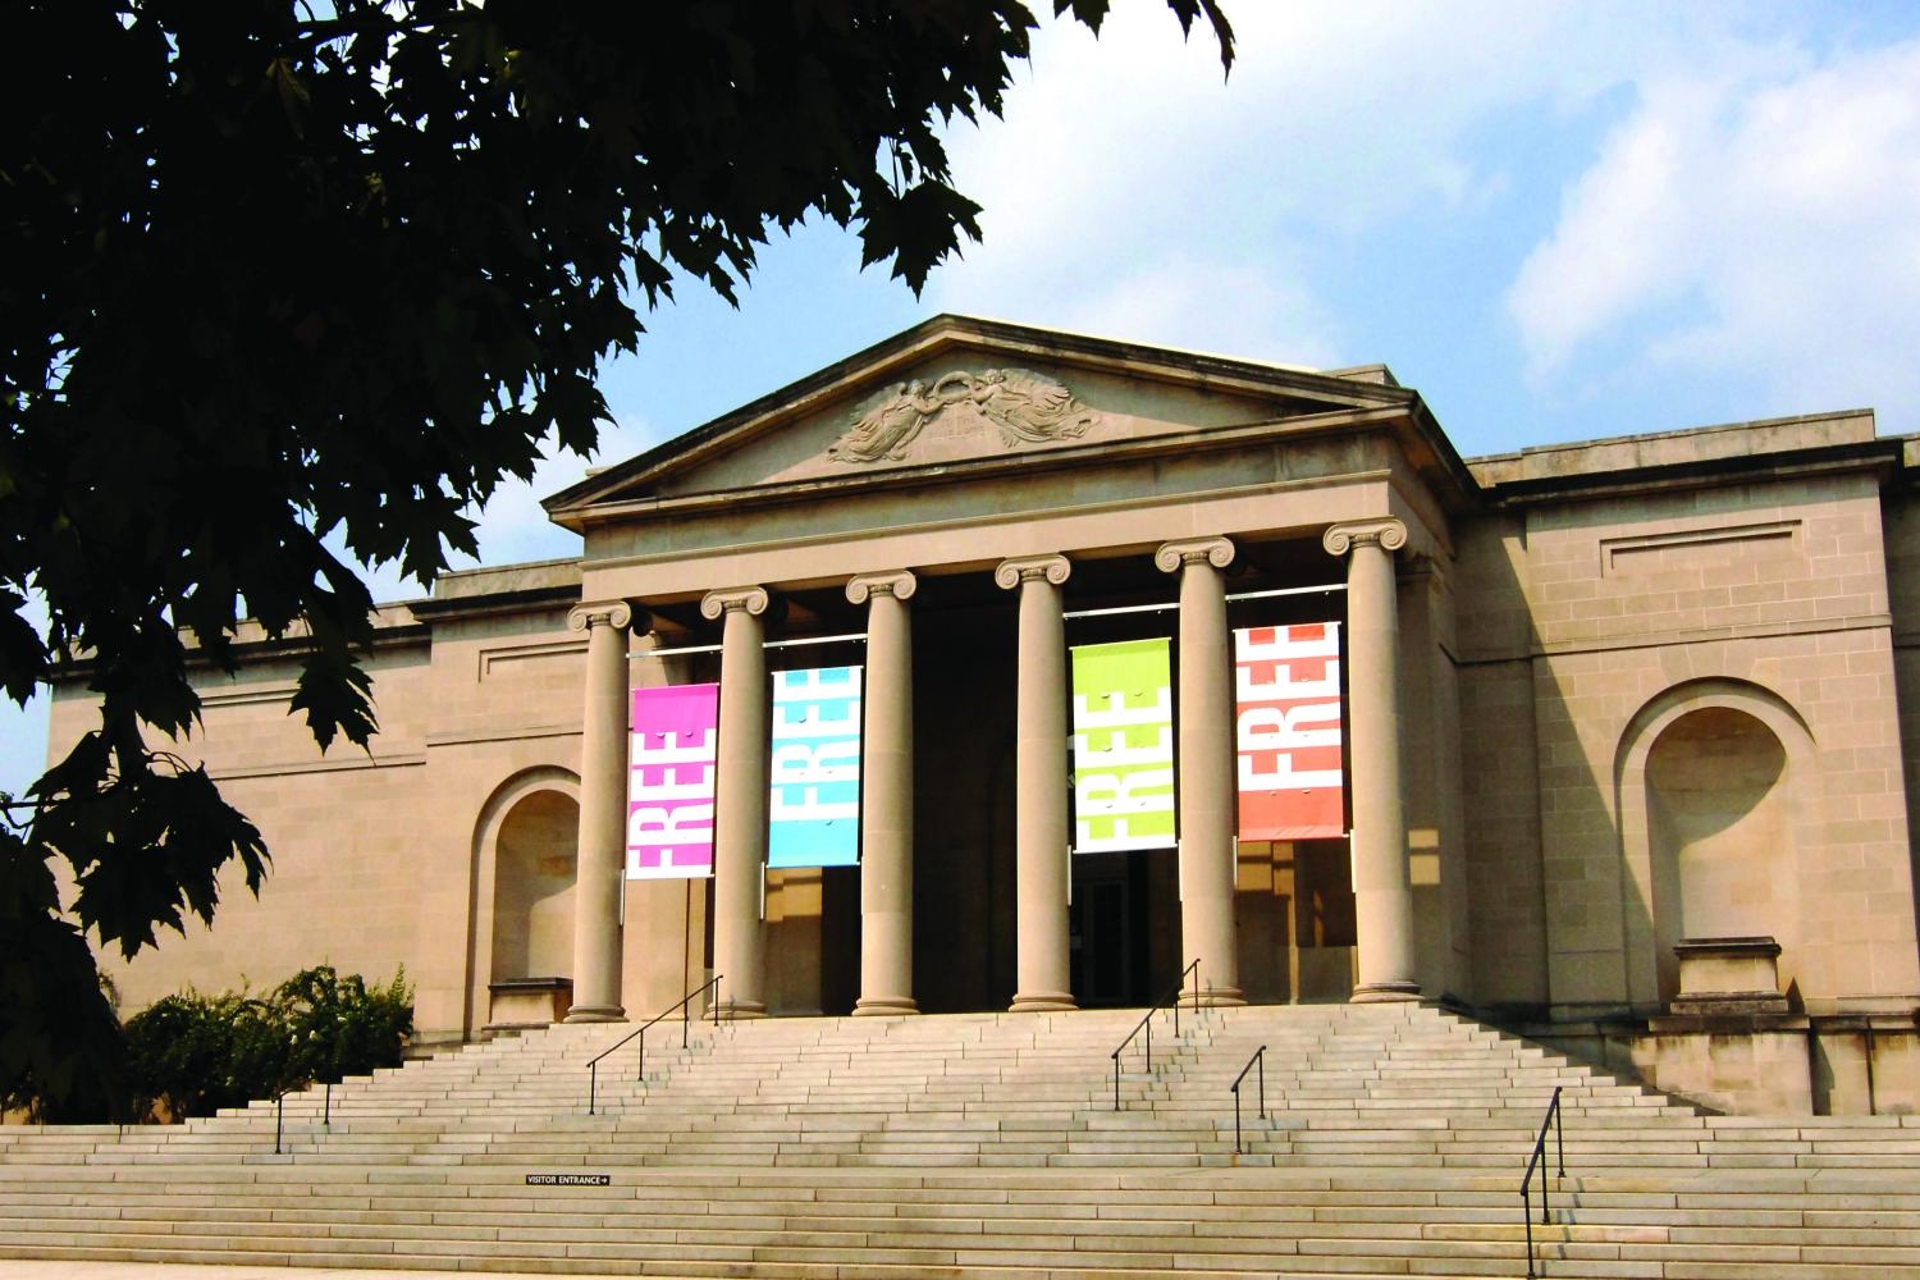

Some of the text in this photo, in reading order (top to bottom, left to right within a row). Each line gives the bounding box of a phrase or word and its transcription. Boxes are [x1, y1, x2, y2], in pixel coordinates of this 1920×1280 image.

[769, 666, 861, 822] FREE
[1074, 686, 1176, 853] FREE
[1235, 622, 1342, 792] FREE
[626, 728, 717, 879] FREE
[528, 1175, 600, 1184] VISITOR ENTRANCE
